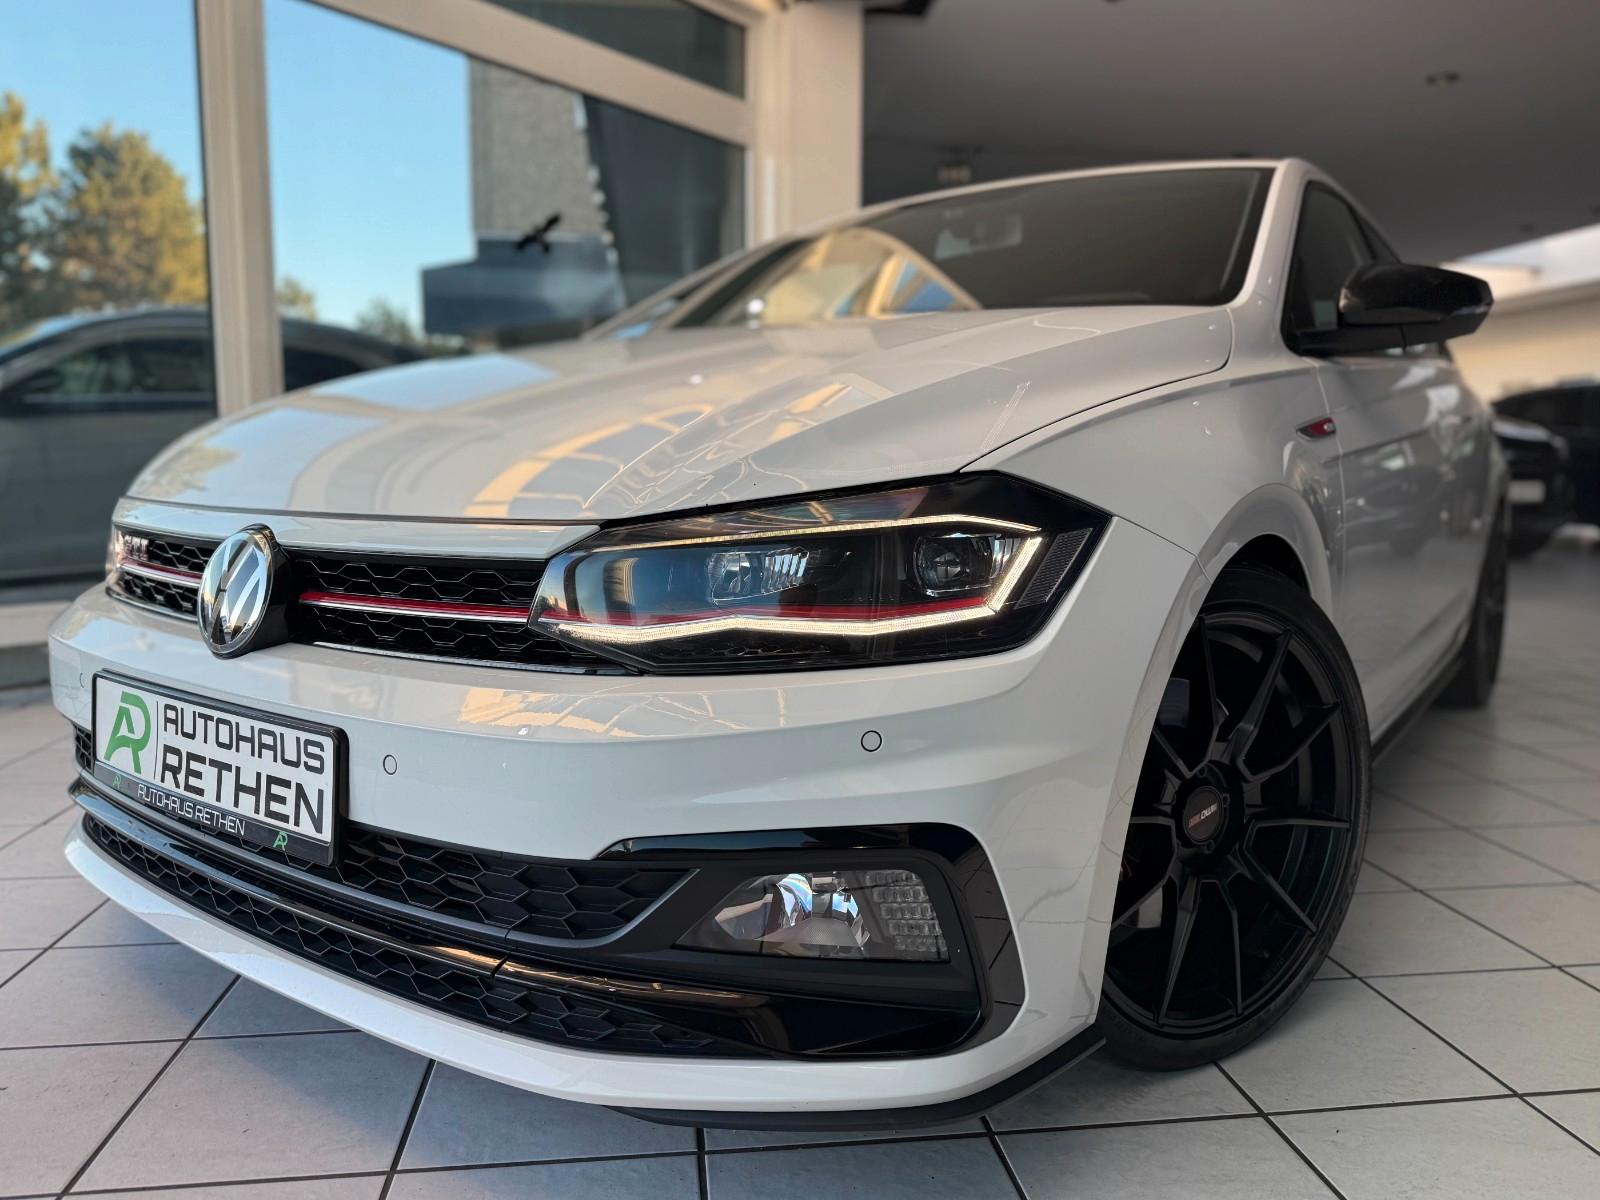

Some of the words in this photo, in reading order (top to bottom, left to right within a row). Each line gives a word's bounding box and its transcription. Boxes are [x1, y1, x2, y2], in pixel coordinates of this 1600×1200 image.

[163, 703, 325, 775] AUTOHAUS
[137, 784, 193, 818] AUTOHAUS
[195, 805, 246, 836] RETHEN
[160, 743, 324, 834] RETHEN
